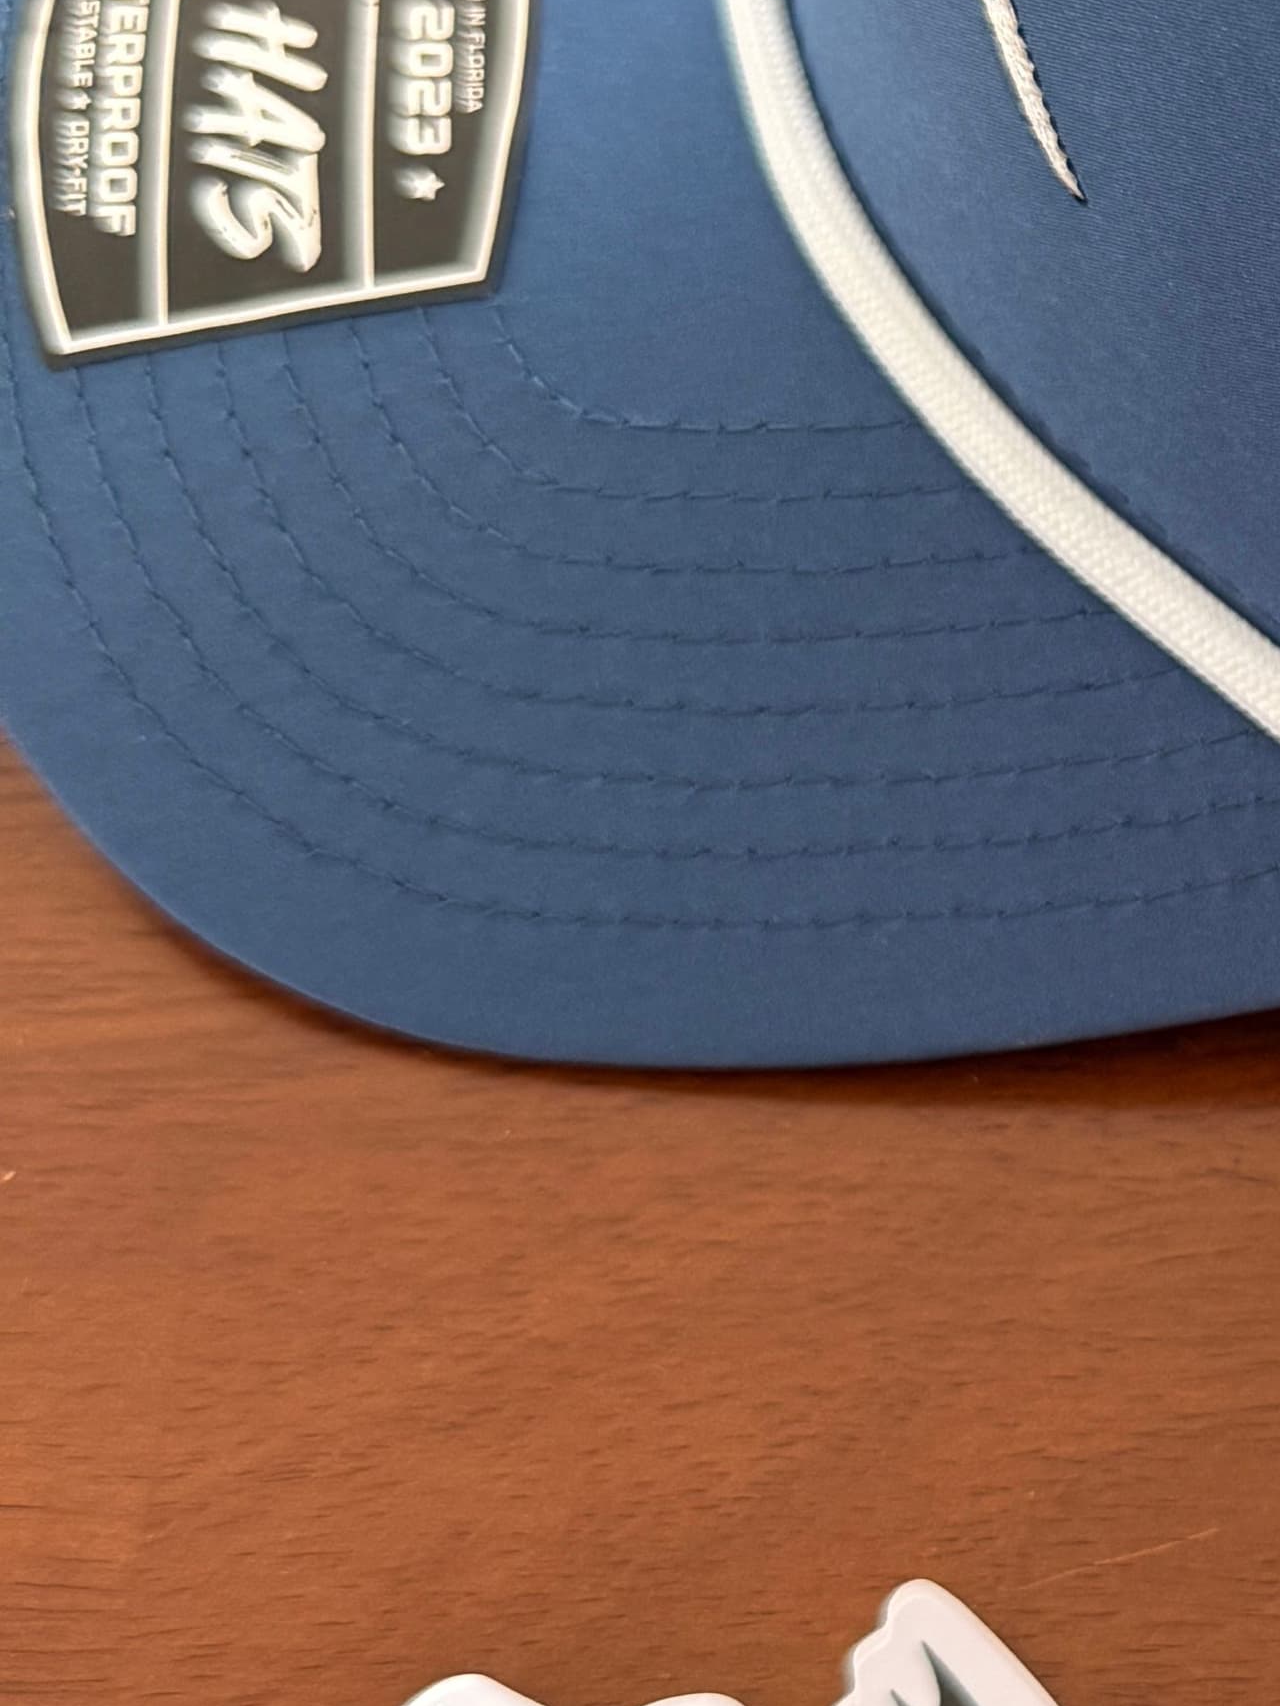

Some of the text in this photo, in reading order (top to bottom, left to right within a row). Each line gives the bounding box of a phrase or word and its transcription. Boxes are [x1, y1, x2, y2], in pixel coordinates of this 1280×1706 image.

[466, 6, 487, 26] IN
[405, 4, 455, 155] 2023
[463, 32, 486, 113] FLORIDA
[66, 121, 91, 216] DRY-FIT
[188, 1, 328, 272] HATS
